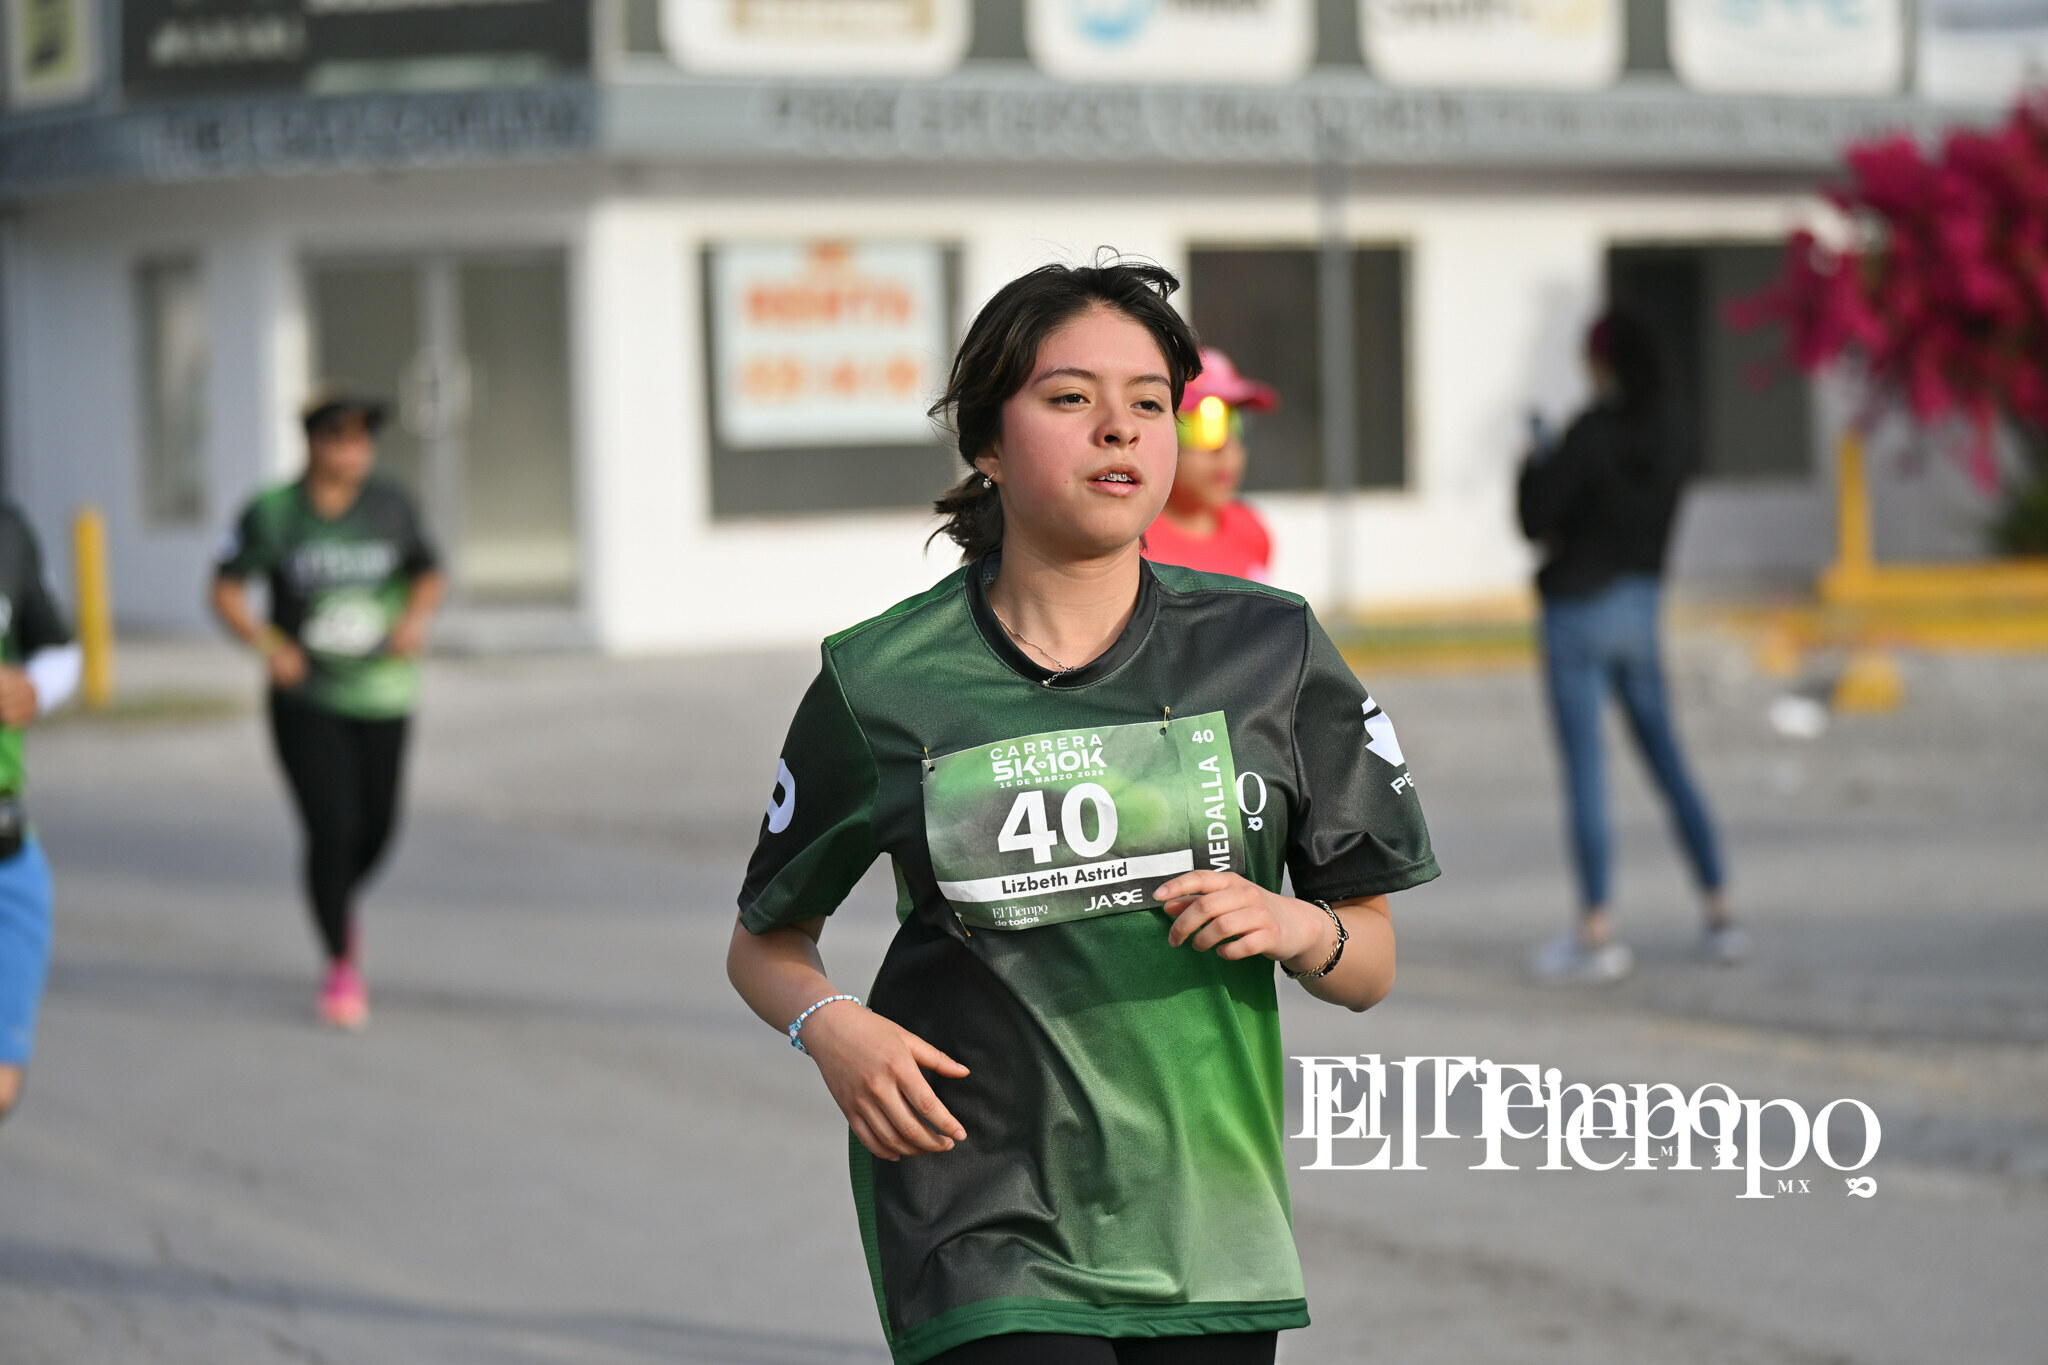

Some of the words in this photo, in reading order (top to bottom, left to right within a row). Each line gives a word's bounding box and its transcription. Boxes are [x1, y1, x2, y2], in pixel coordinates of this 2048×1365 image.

[1191, 729, 1215, 744] 40
[990, 734, 1103, 760] CARRERA
[1000, 781, 1012, 789] 15
[1036, 773, 1073, 784] MARZO
[997, 783, 1118, 864] 40
[1001, 872, 1068, 895] Lizbeth
[1074, 862, 1128, 884] Astrid
[992, 906, 1004, 919] El
[1005, 904, 1049, 917] Tiempo
[1008, 917, 1039, 926] todos
